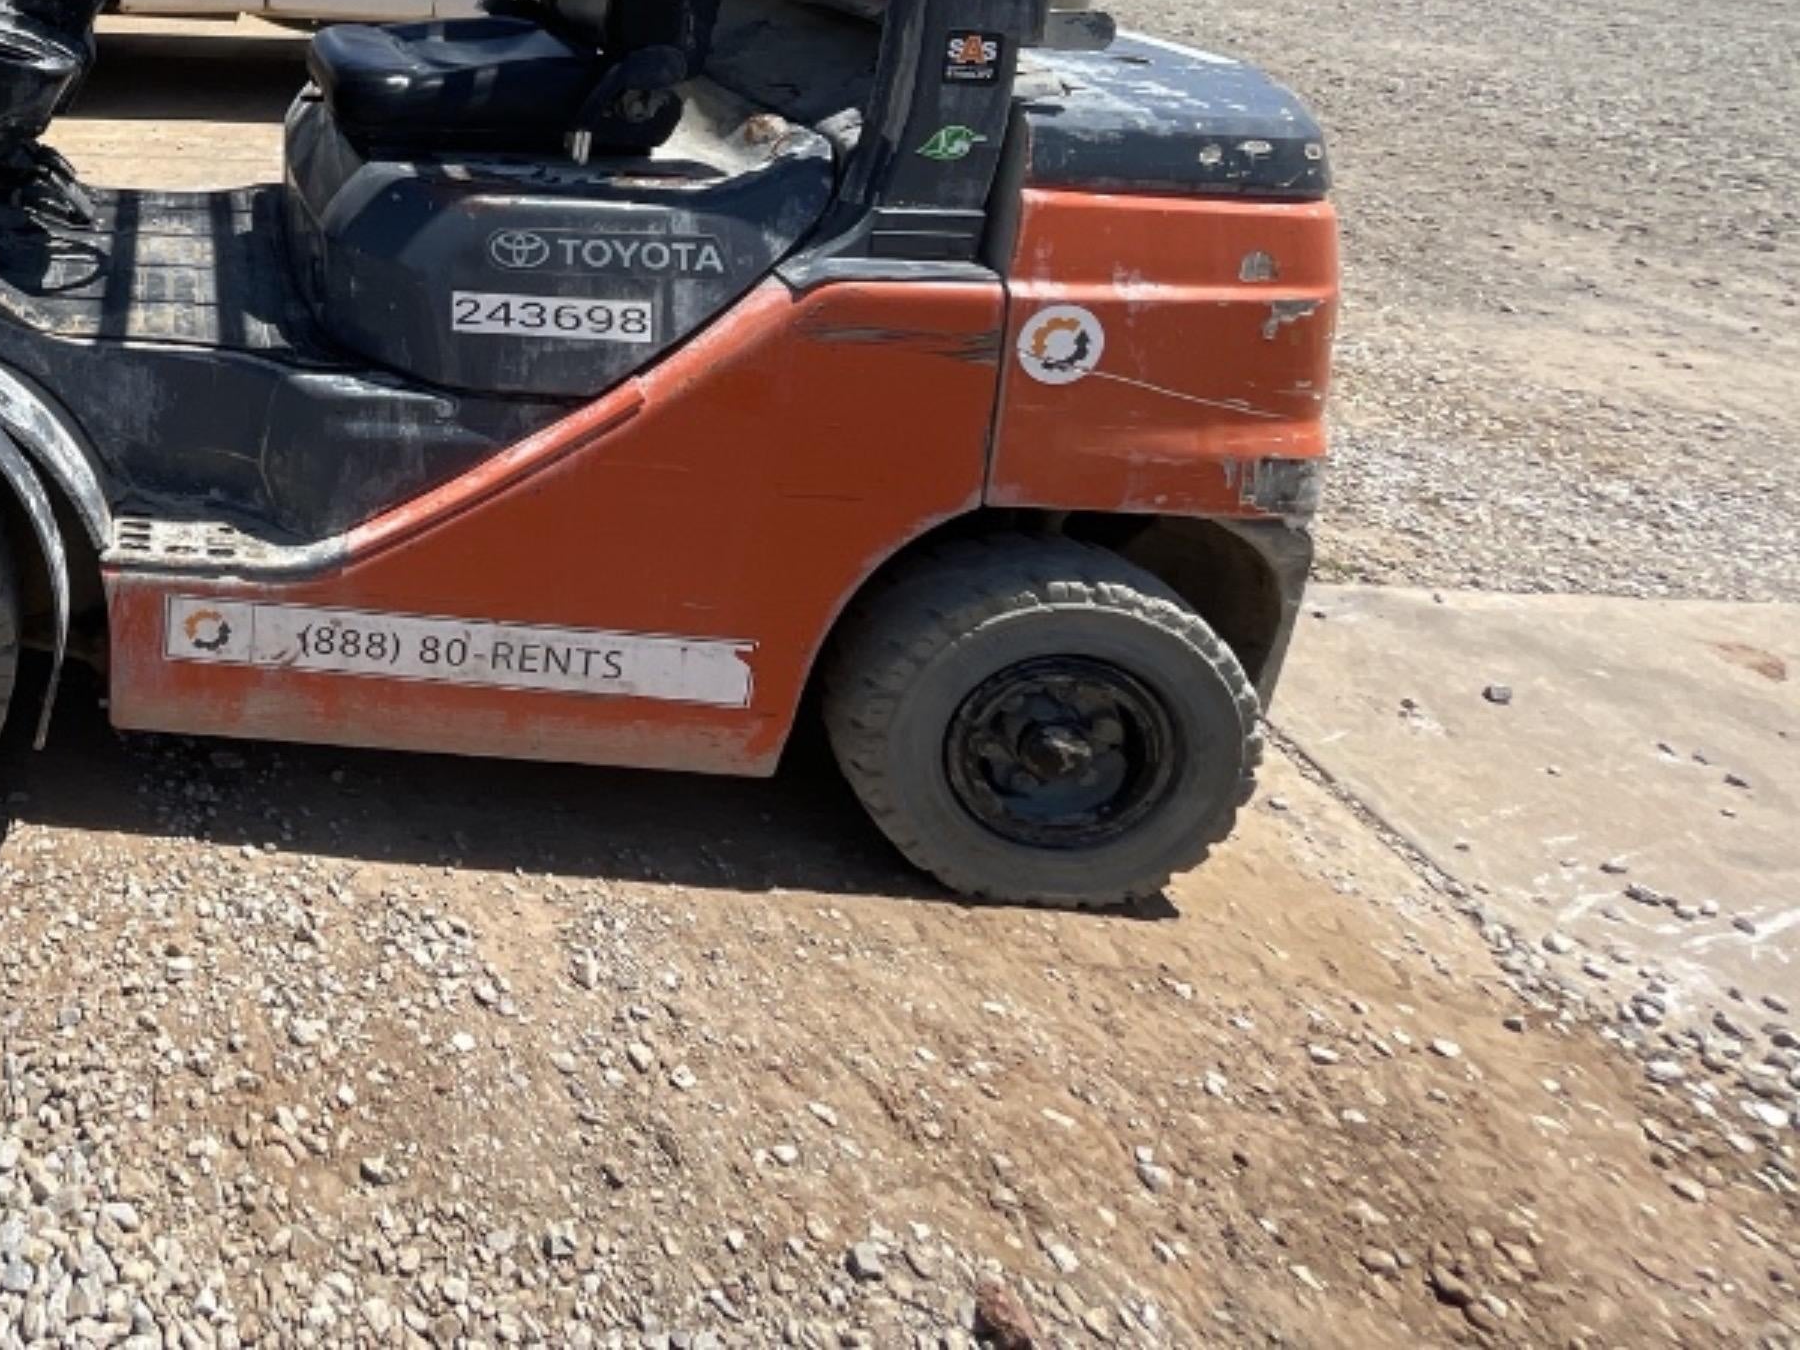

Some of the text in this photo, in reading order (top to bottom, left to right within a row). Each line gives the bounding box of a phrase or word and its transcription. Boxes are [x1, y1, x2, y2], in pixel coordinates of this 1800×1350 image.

[947, 34, 998, 64] SAS
[557, 238, 724, 274] TOYOTA
[454, 298, 648, 334] 243698
[300, 624, 622, 679] (888) 80-RENTS
